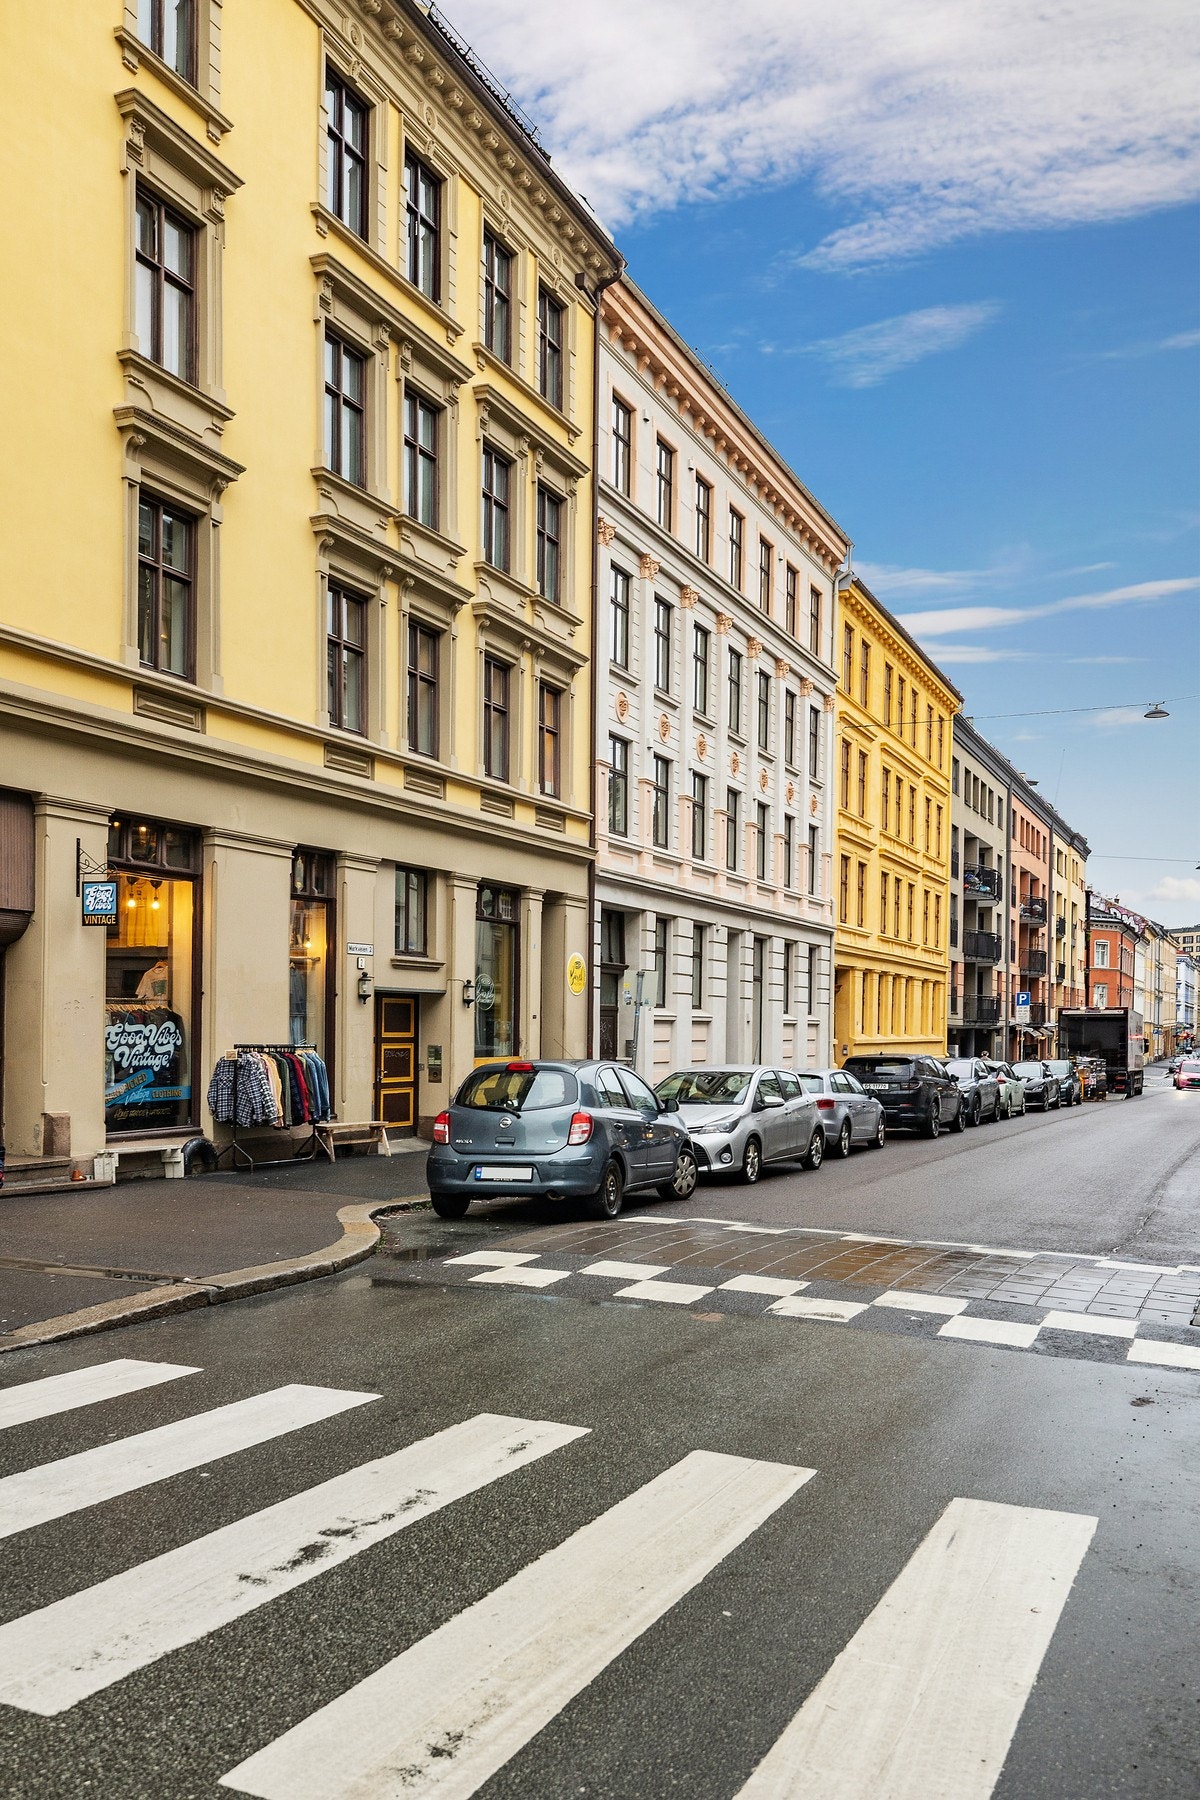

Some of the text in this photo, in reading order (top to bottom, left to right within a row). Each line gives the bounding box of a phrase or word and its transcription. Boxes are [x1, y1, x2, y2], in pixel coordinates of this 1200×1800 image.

[86, 885, 114, 901] Good
[86, 896, 112, 911] Vibes
[84, 915, 117, 924] VINTAGE
[1019, 994, 1027, 1004] P
[105, 1021, 182, 1053] Good Vibes
[114, 1045, 170, 1071] Vintage
[152, 1089, 182, 1098] CLOTHING
